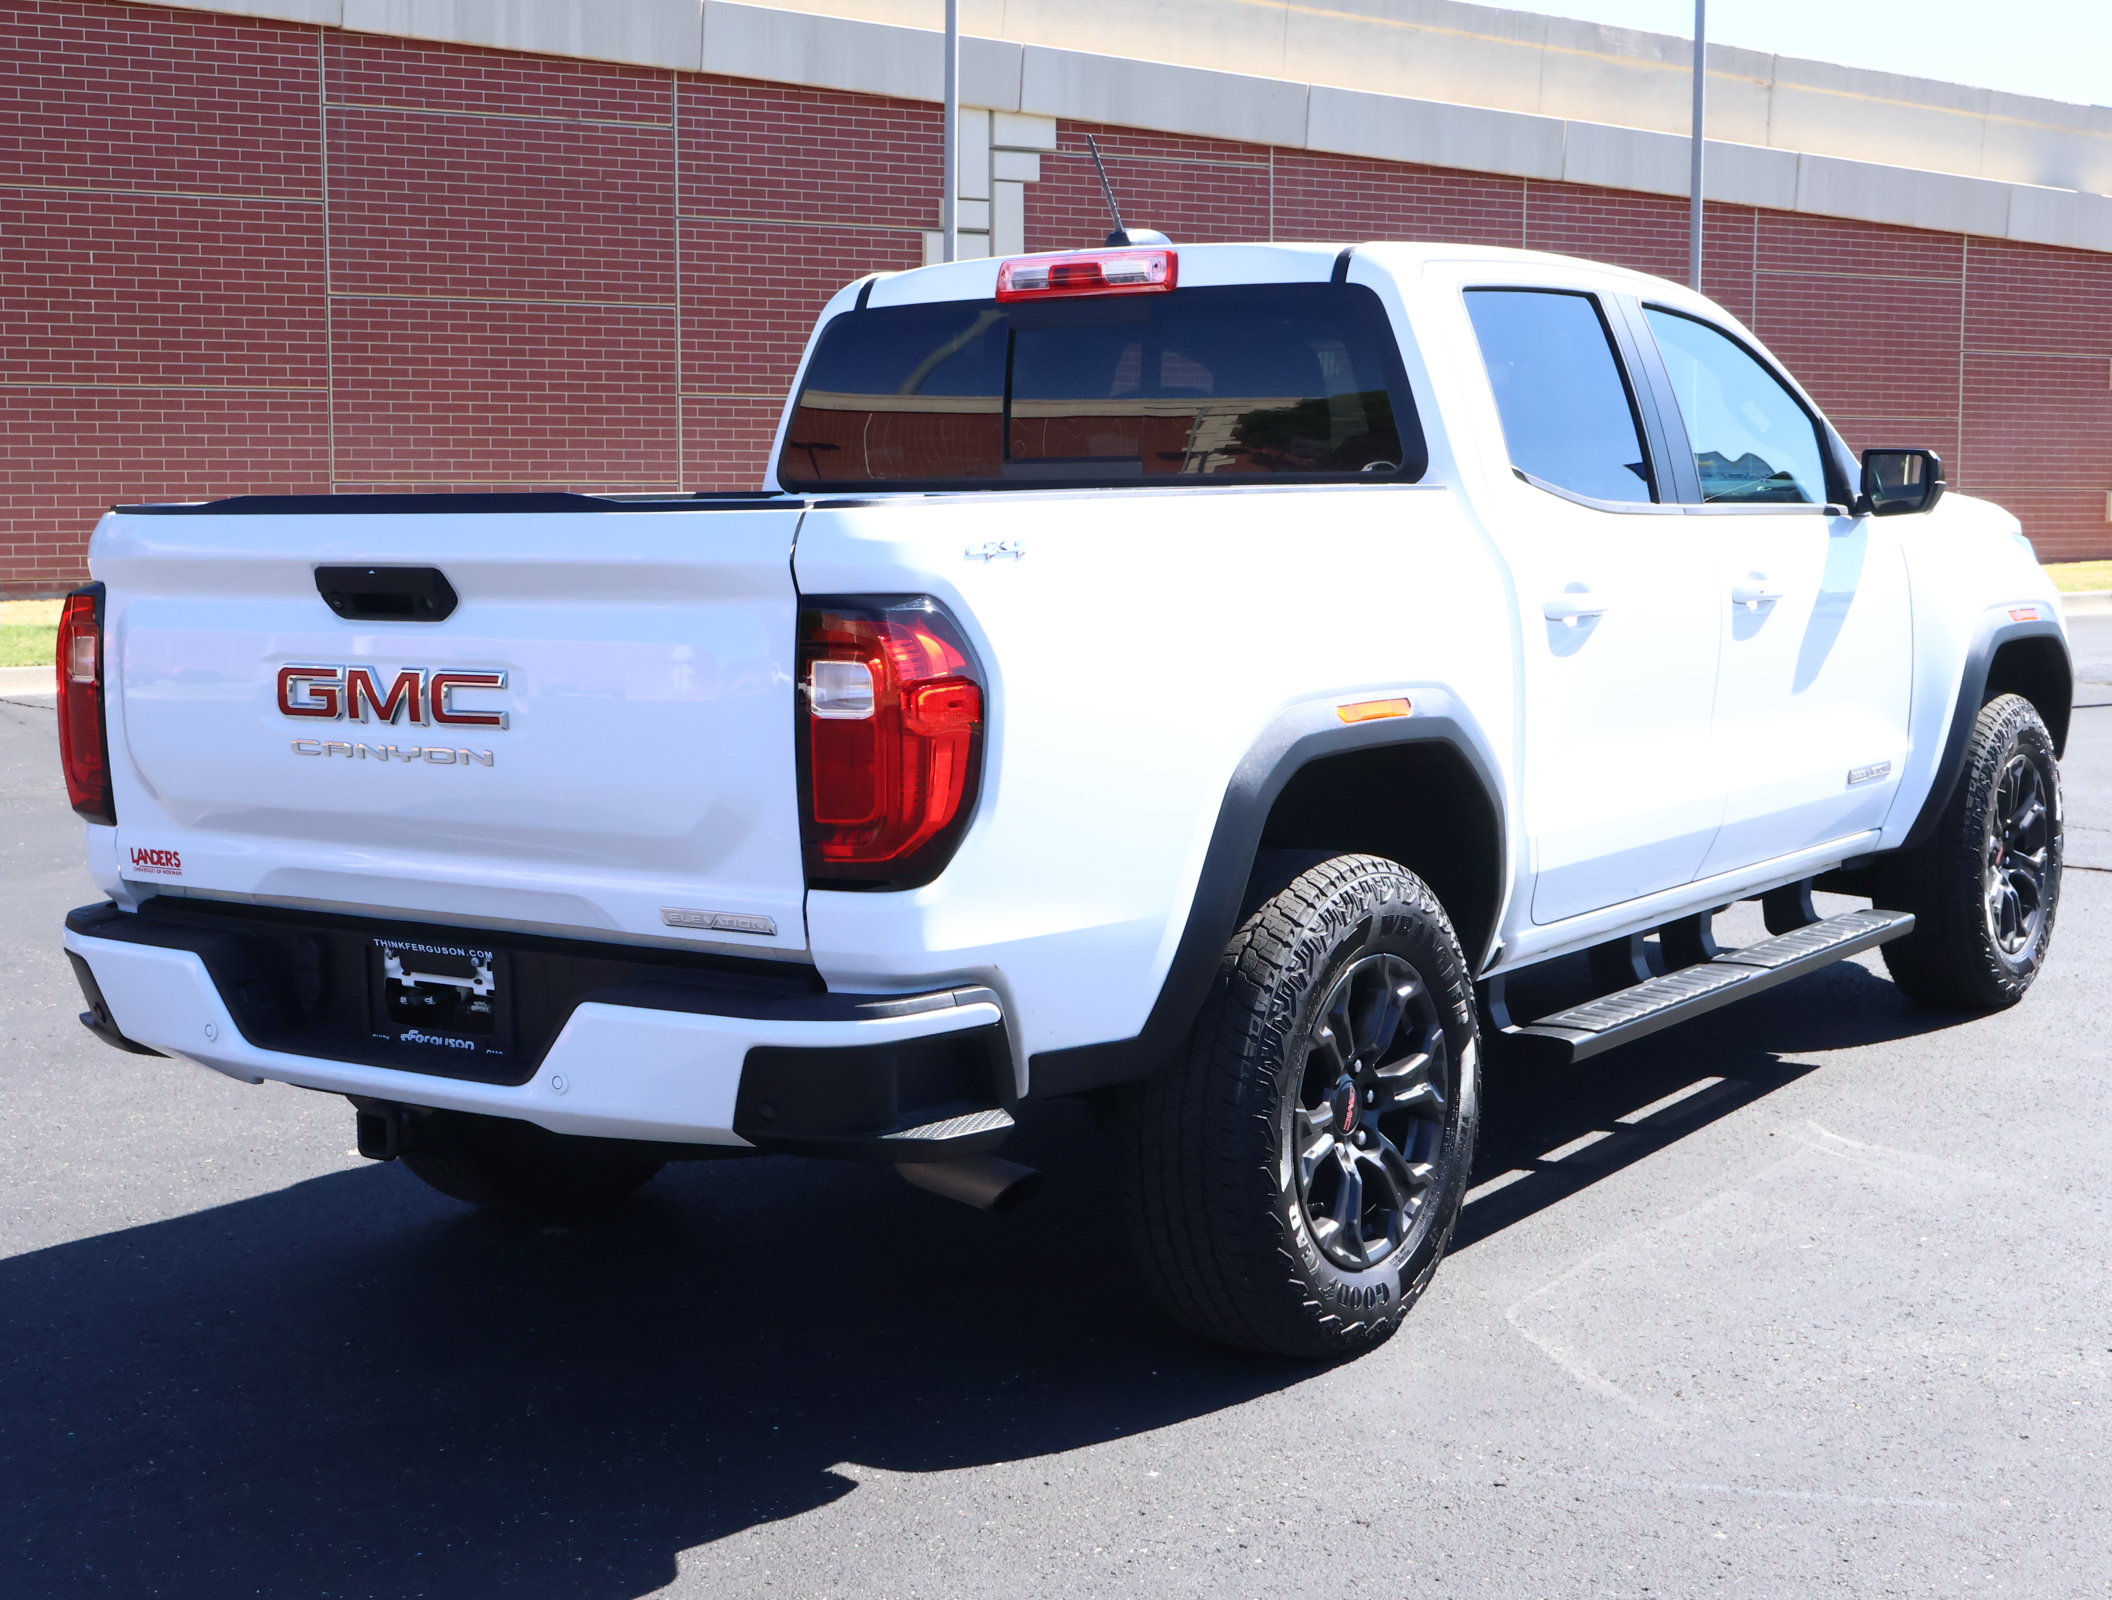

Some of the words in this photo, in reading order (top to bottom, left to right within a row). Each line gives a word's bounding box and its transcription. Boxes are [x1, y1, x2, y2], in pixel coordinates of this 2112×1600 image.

[277, 662, 509, 731] GMC
[291, 738, 494, 767] CANYON
[130, 847, 181, 868] LANDERS
[667, 911, 767, 930] ELEVATION
[373, 938, 494, 960] THINKFERGUSON.COM
